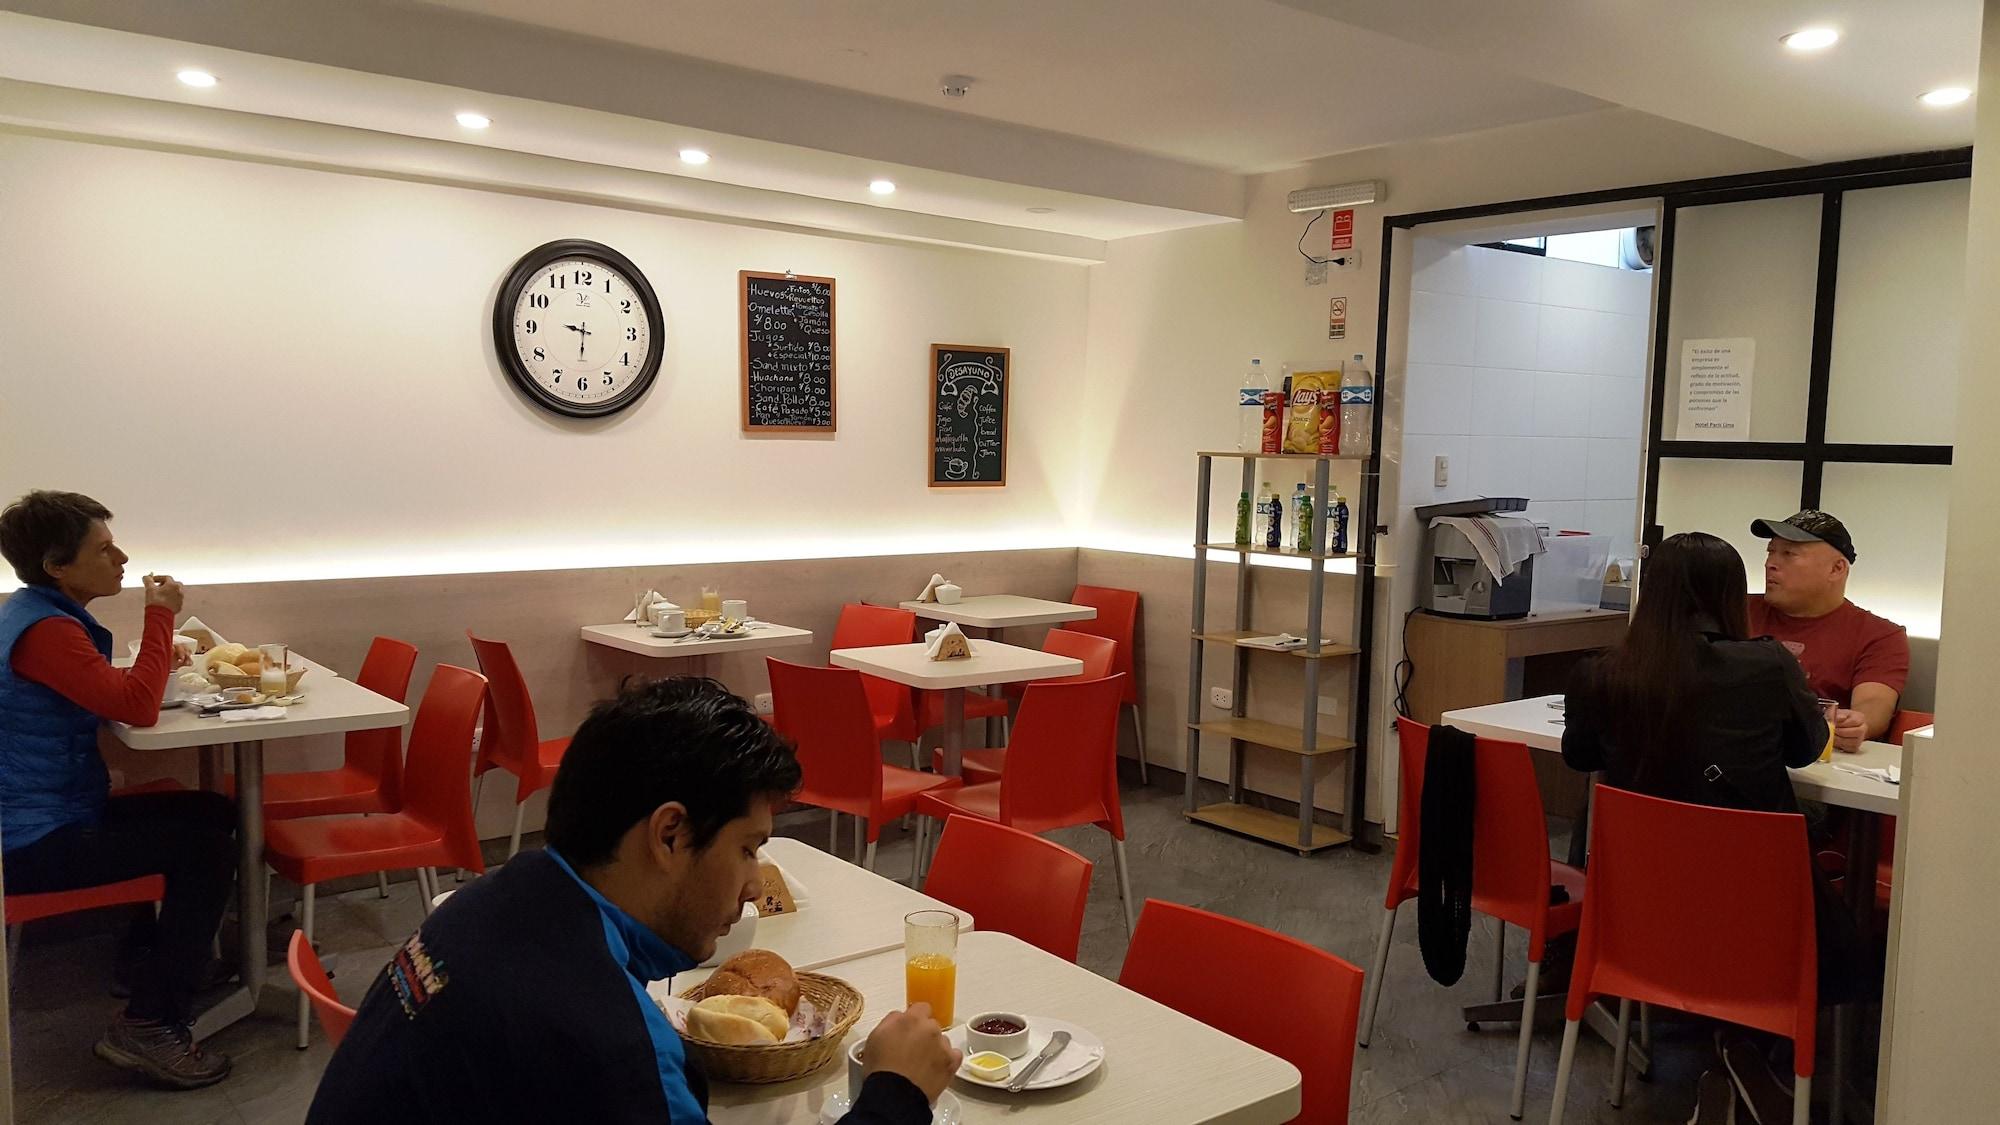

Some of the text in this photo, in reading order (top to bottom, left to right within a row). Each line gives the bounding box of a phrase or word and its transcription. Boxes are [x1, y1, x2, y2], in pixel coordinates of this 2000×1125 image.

[550, 274, 565, 289] 11
[574, 271, 592, 285] 12
[605, 279, 610, 293] 1
[751, 284, 785, 299] Huevos
[530, 292, 549, 308] 10
[789, 293, 825, 304] Revueltos
[621, 300, 630, 314] 2
[526, 320, 537, 334] 9
[804, 325, 829, 335] Queso
[627, 328, 637, 341] 3
[751, 330, 784, 343] Jugos
[773, 342, 804, 351] Surtido
[534, 347, 545, 361] 8
[620, 352, 629, 366] 4
[774, 352, 807, 360] Especial
[782, 362, 808, 371] mixto
[948, 366, 989, 379] DESAYUNO
[553, 369, 562, 383] 7
[602, 371, 613, 385] 5
[578, 377, 587, 391] 6
[783, 393, 804, 404] Pollo
[756, 403, 778, 413] Café
[781, 404, 808, 414] Pasado
